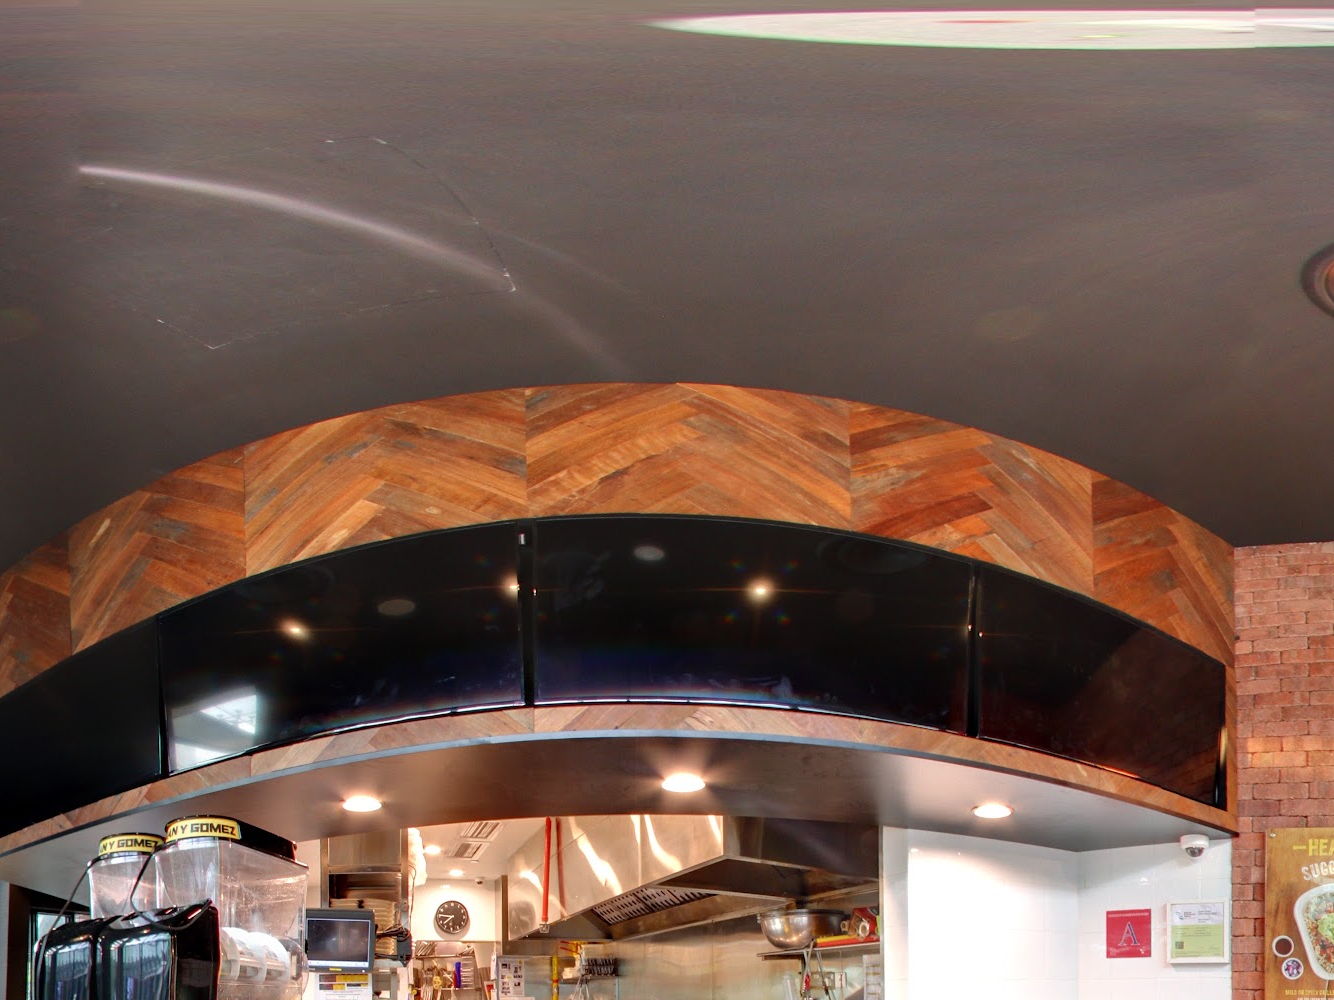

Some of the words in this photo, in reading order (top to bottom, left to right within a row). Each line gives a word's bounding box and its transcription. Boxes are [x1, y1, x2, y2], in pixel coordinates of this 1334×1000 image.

[190, 823, 236, 836] GOMEZ
[117, 838, 158, 848] GOMEZ
[1118, 921, 1141, 946] A
